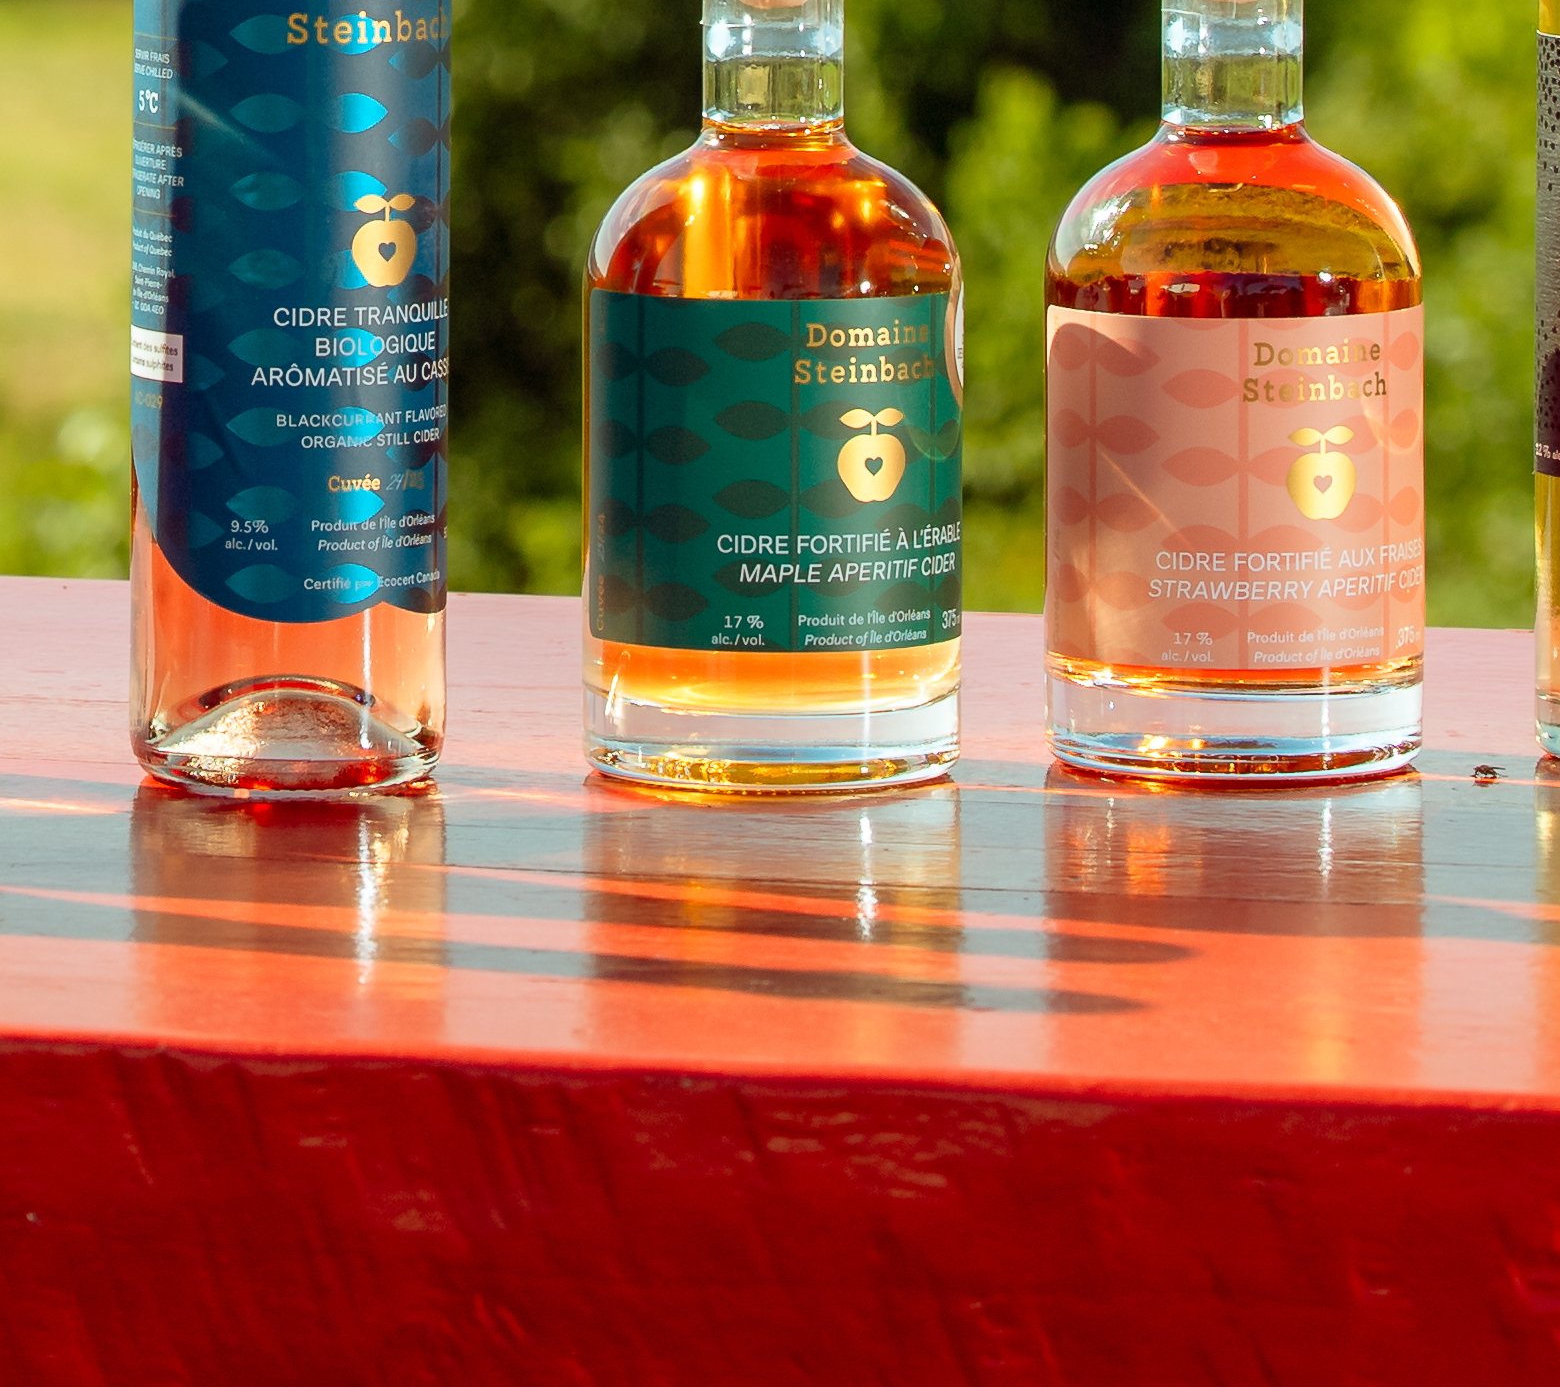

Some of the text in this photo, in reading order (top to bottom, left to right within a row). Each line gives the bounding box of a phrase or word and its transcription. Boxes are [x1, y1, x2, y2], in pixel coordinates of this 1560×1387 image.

[287, 8, 448, 44] Steinbach
[274, 299, 448, 326] CIDRE TRANQUILLE
[315, 331, 435, 356] BIOLOGIQUE
[806, 320, 928, 348] Domaine
[1254, 339, 1380, 367] Domaine
[251, 362, 416, 386] ARÔMATISÉ AU
[795, 353, 934, 384] Steinbach
[1243, 372, 1387, 402] Steinbach
[276, 412, 401, 427] BLACKCURRANT
[301, 428, 440, 448] ORGANIC STILL CIDER
[328, 475, 380, 492] Cuvée
[717, 521, 960, 554] CIDRE FORTIFIÉ À L'ÉRABLE
[740, 552, 955, 583] MAPLE APERITIF CIDER
[1156, 538, 1422, 571] CIDRE FORTIFIÉ AUX FRAISES
[1148, 572, 1396, 600] STRAWBERRY APERITIF
[798, 614, 844, 627] Produit
[848, 613, 863, 625] de
[942, 610, 956, 629] 375
[805, 633, 854, 646] Product
[857, 632, 868, 645] of
